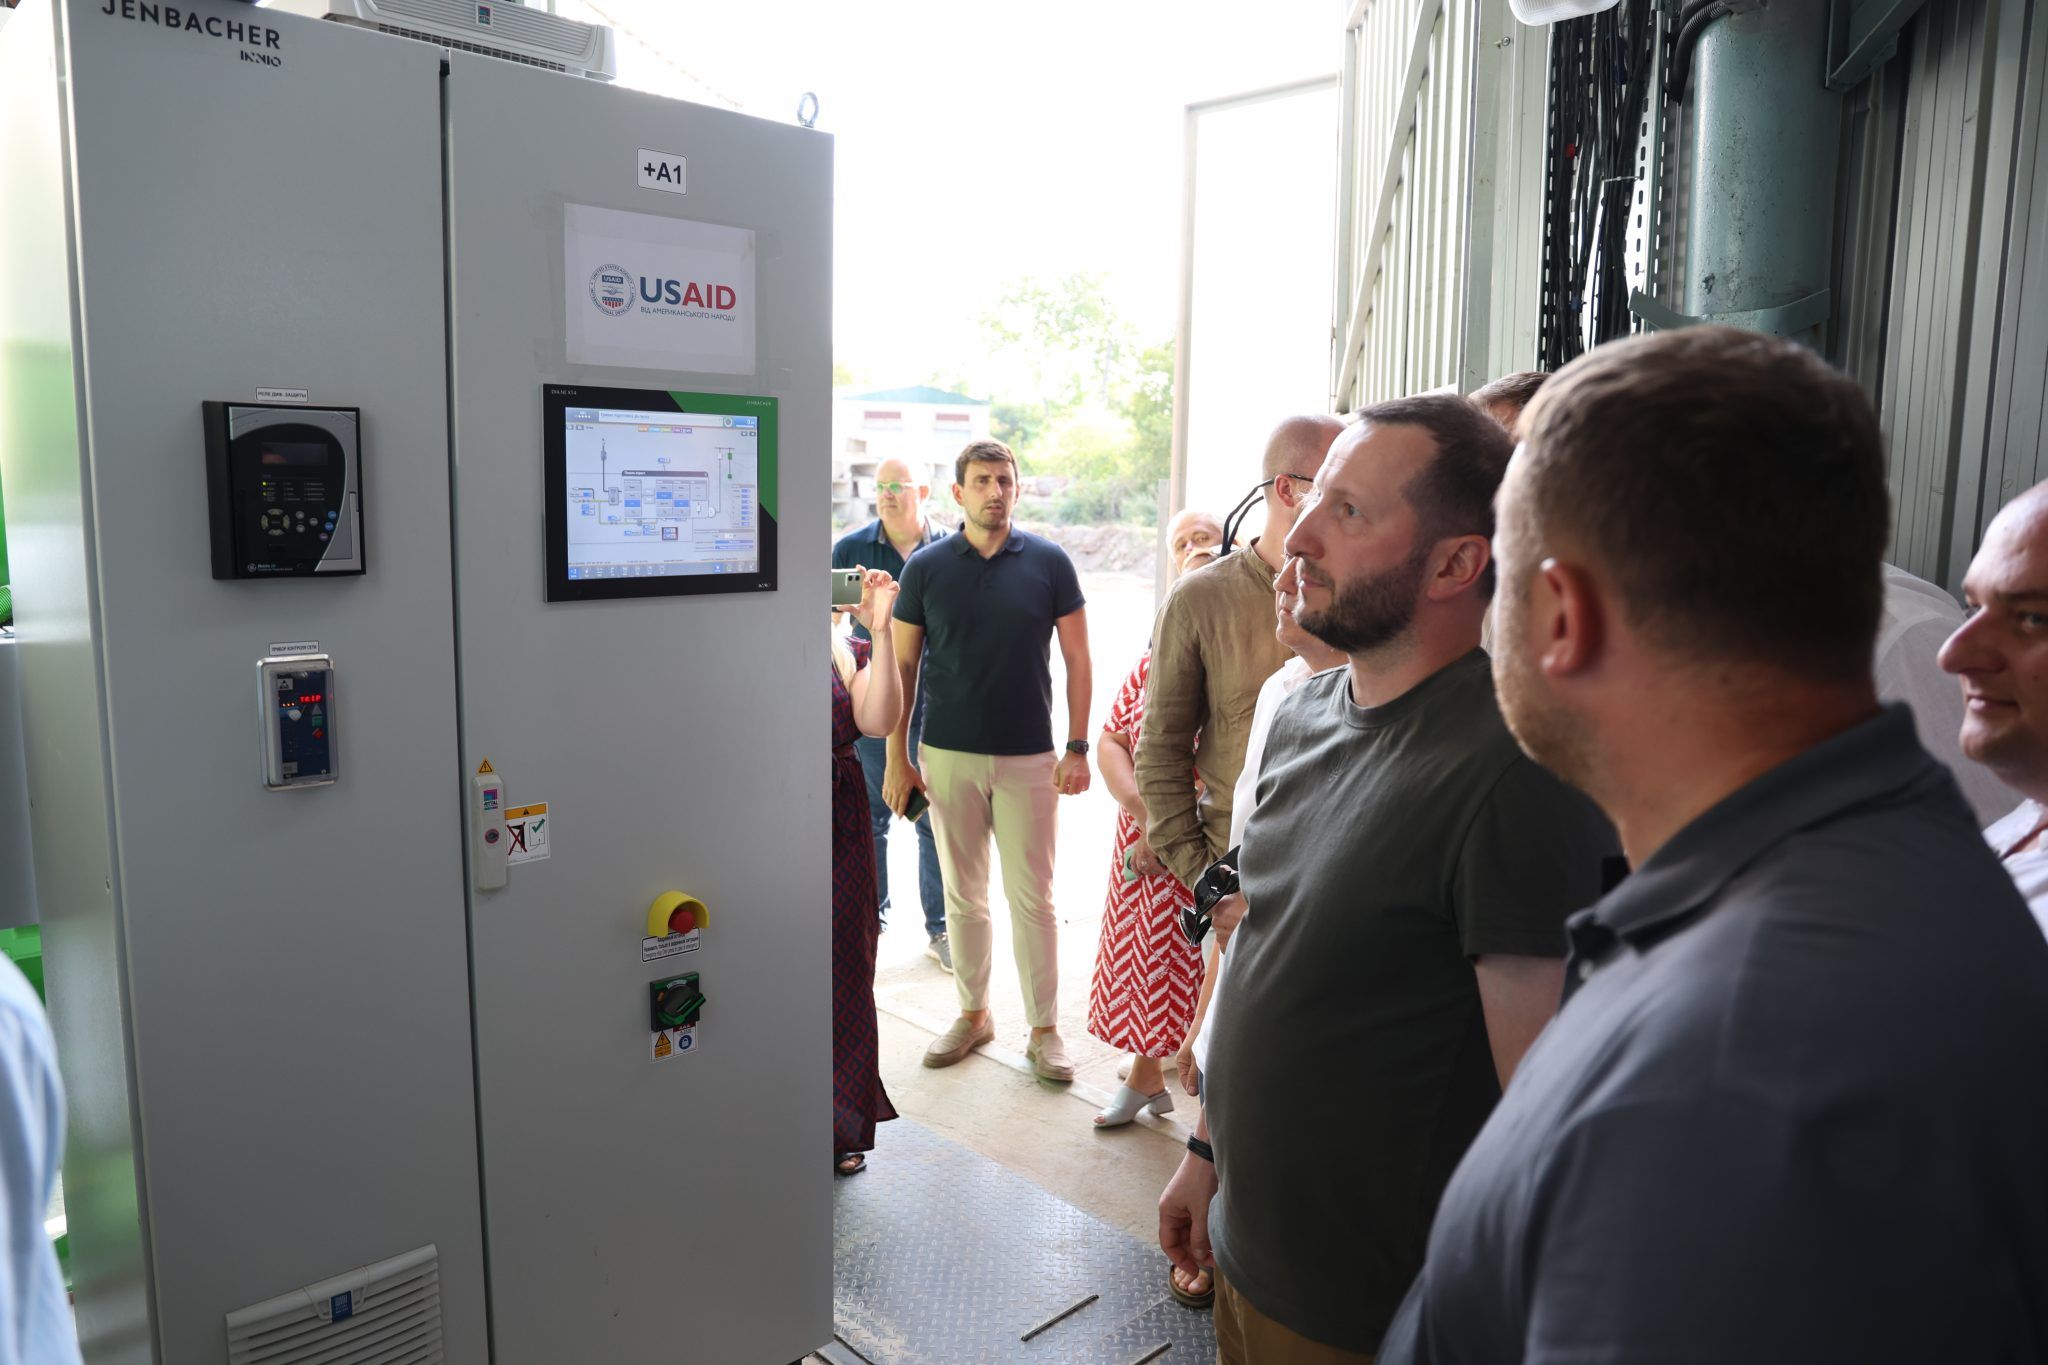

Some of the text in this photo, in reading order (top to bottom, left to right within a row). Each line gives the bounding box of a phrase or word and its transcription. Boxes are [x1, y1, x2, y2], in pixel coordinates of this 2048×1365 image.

[102, 0, 281, 49] JENBACHER
[240, 50, 282, 67] INNIO
[643, 162, 681, 184] +A1
[639, 276, 737, 310] USAID
[640, 306, 736, 322] ВІД АМЕРИКАНСЬКОГО НАРОДУ
[299, 694, 322, 703] TRIP
